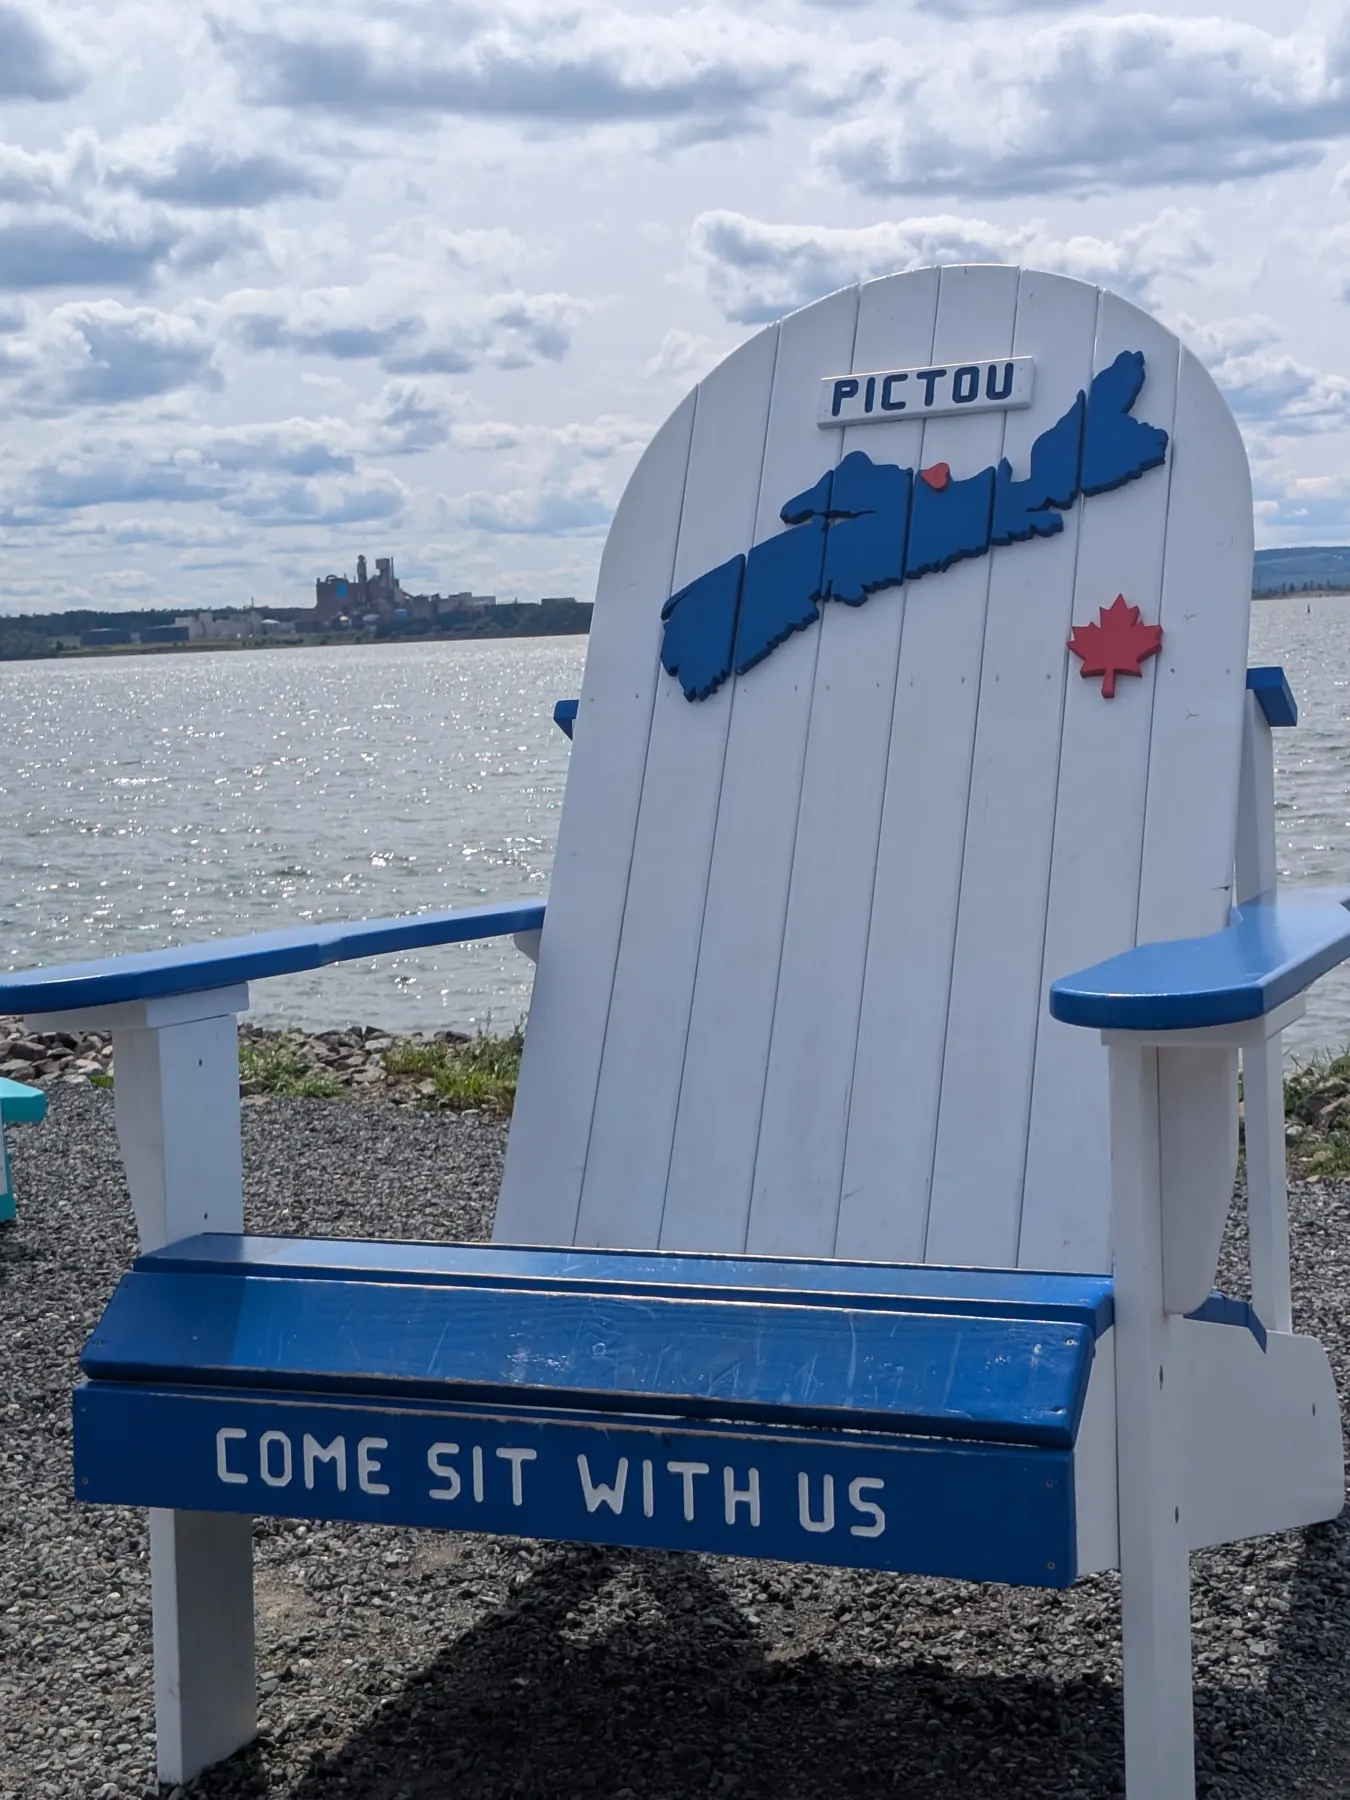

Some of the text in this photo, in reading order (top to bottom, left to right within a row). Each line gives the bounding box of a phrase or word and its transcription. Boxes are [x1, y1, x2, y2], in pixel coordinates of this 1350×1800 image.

[831, 362, 1014, 417] PICTOU
[216, 1427, 886, 1538] COME SIT WITH US
